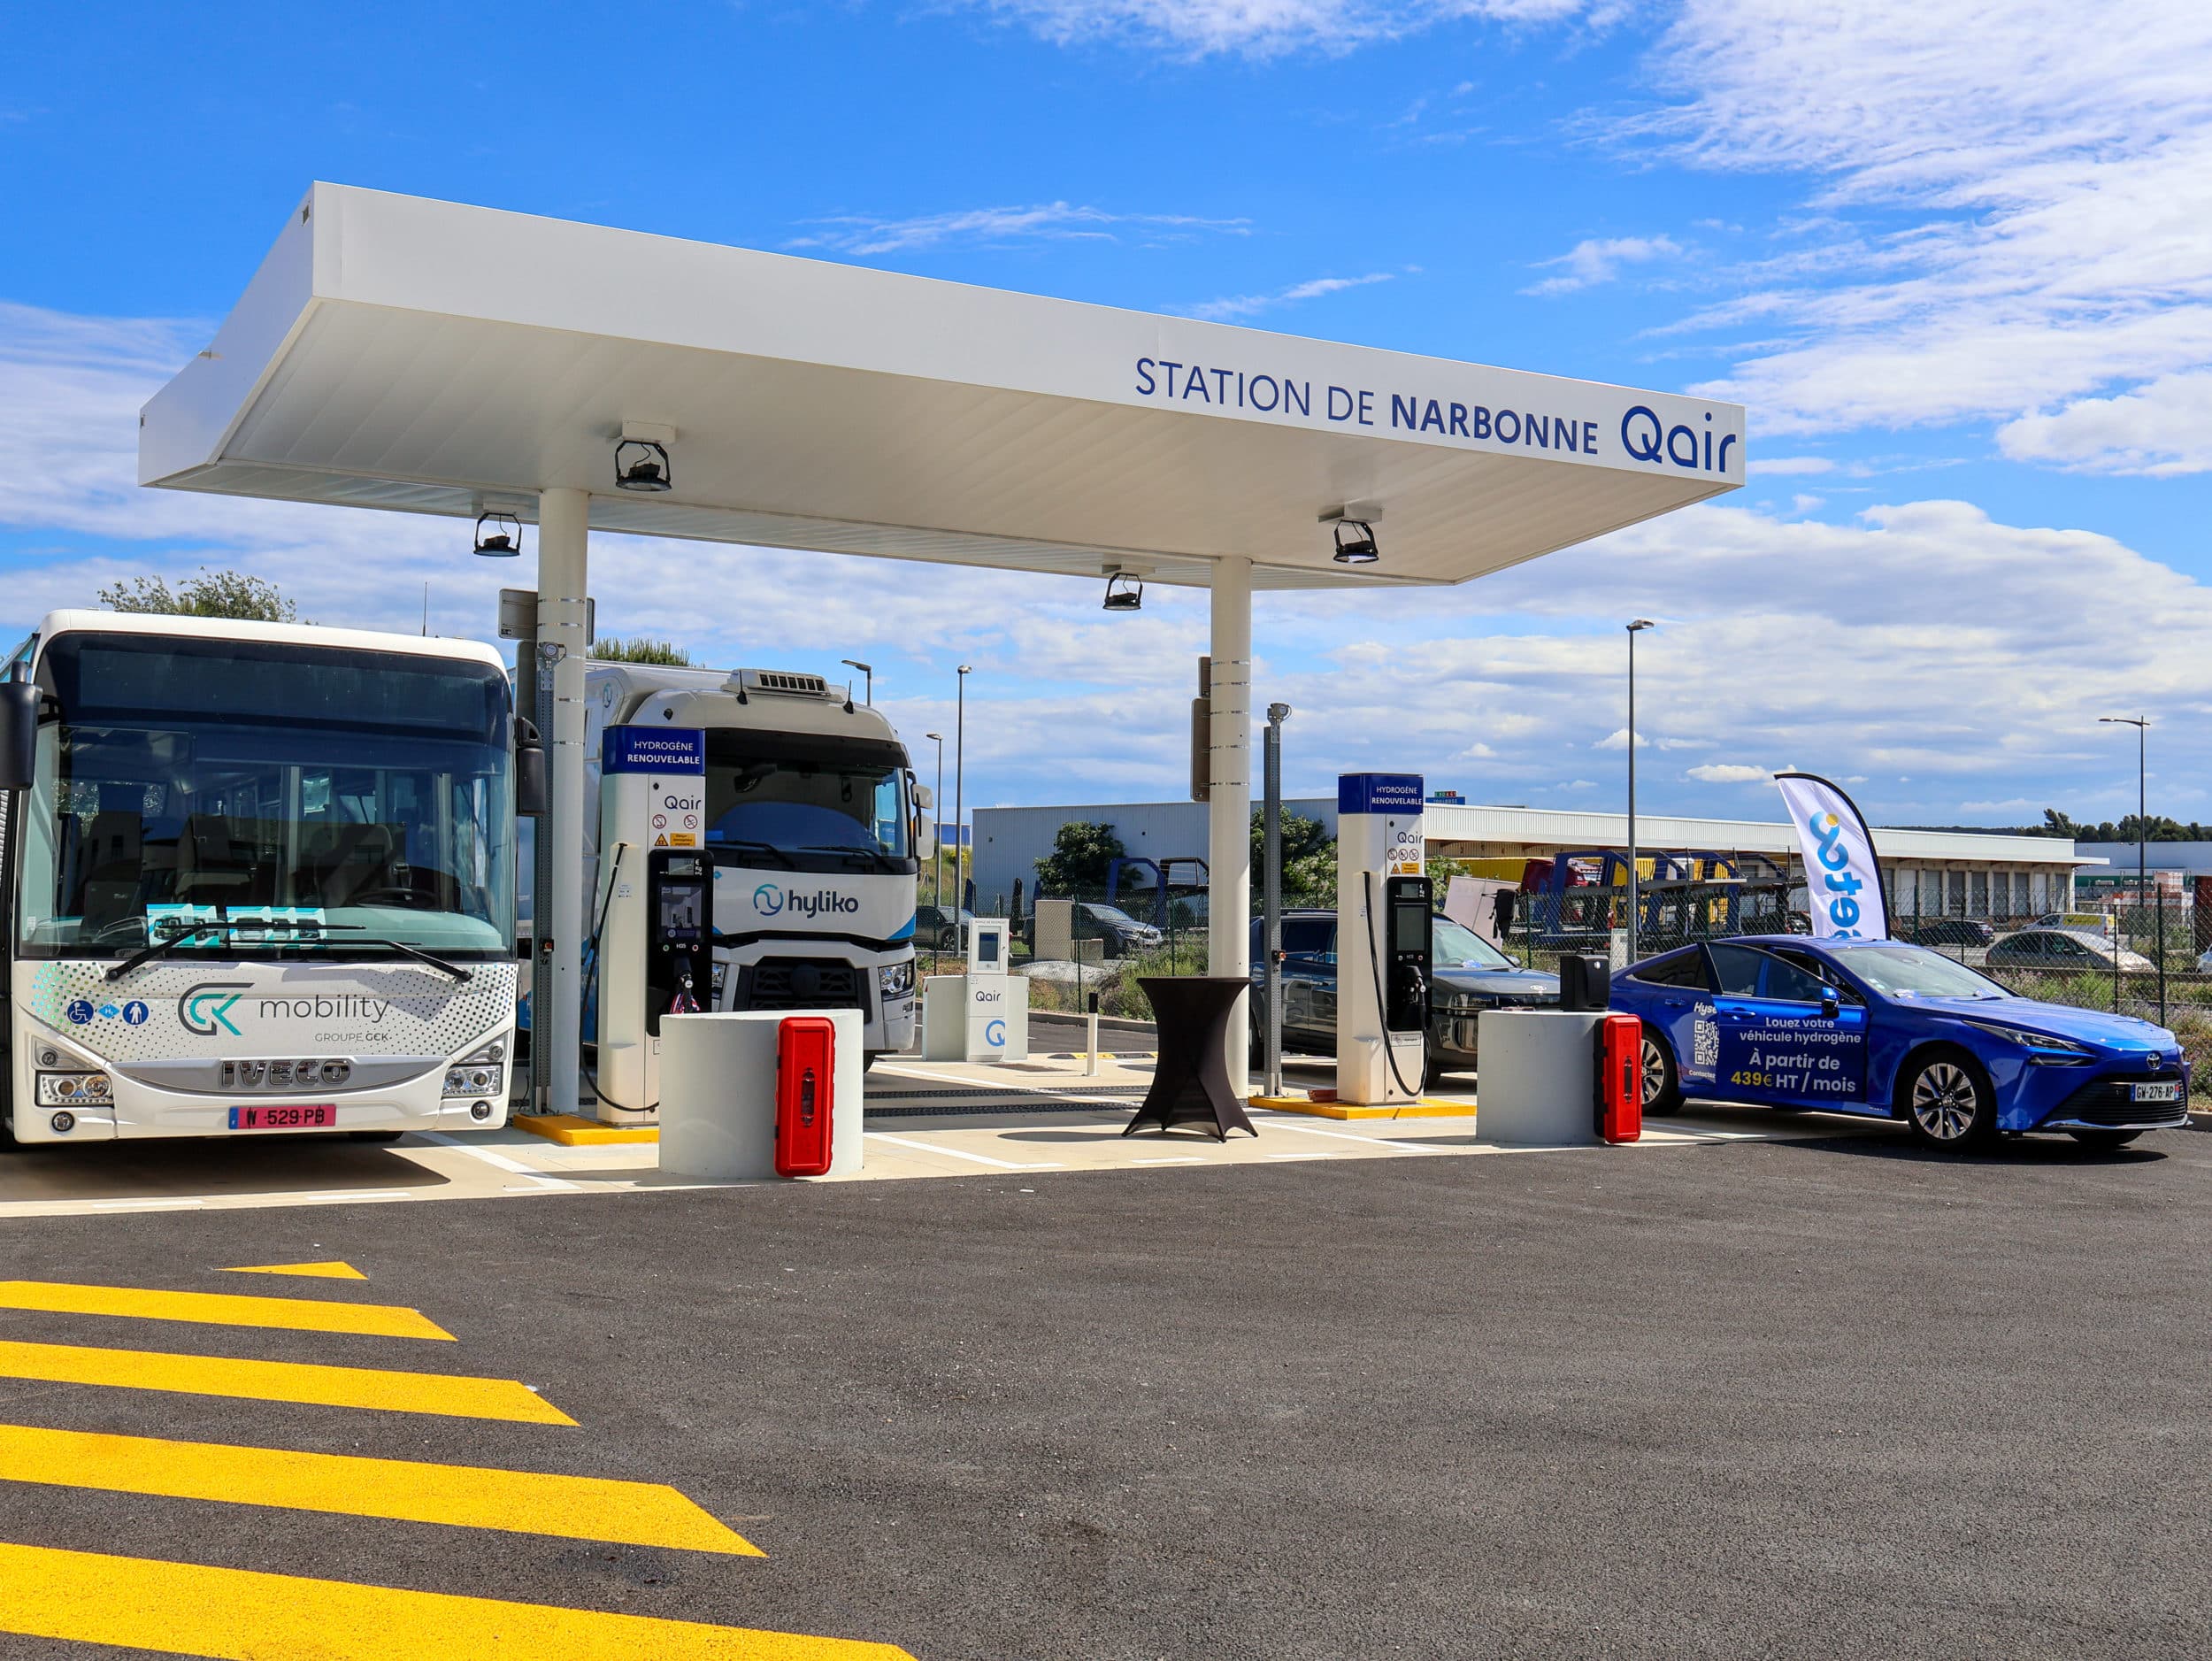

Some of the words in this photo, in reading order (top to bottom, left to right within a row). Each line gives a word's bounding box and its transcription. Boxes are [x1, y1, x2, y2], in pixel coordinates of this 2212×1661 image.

[1135, 357, 1310, 417] STATION
[1328, 385, 1375, 427] DE
[1391, 394, 1599, 456] NARBONNE
[1620, 405, 1737, 473] Qair
[634, 741, 694, 751] HYDROGÈNE
[627, 754, 700, 765] RENOUVELABLE
[664, 795, 702, 810] Qair
[1371, 796, 1423, 805] RENOUVELABLE
[1397, 831, 1424, 844] Qair
[788, 889, 859, 919] hyliko
[975, 989, 1001, 1002] Qair
[260, 995, 388, 1023] mobility
[1765, 1017, 1801, 1028] Louez
[1802, 1019, 1835, 1028] votre
[314, 1032, 364, 1042] GROUPE
[1740, 1030, 1792, 1042] véhicule
[1794, 1032, 1861, 1045] hydrogène
[1748, 1048, 1762, 1065] À
[1765, 1053, 1815, 1071] partir
[1818, 1056, 1840, 1071] de
[221, 1059, 352, 1088] IVECO
[1731, 1071, 1772, 1087] 439€
[1776, 1074, 1798, 1088] HT
[1801, 1072, 1810, 1093] /
[1814, 1077, 1856, 1092] mois
[2136, 1085, 2174, 1099] GW-276-AP
